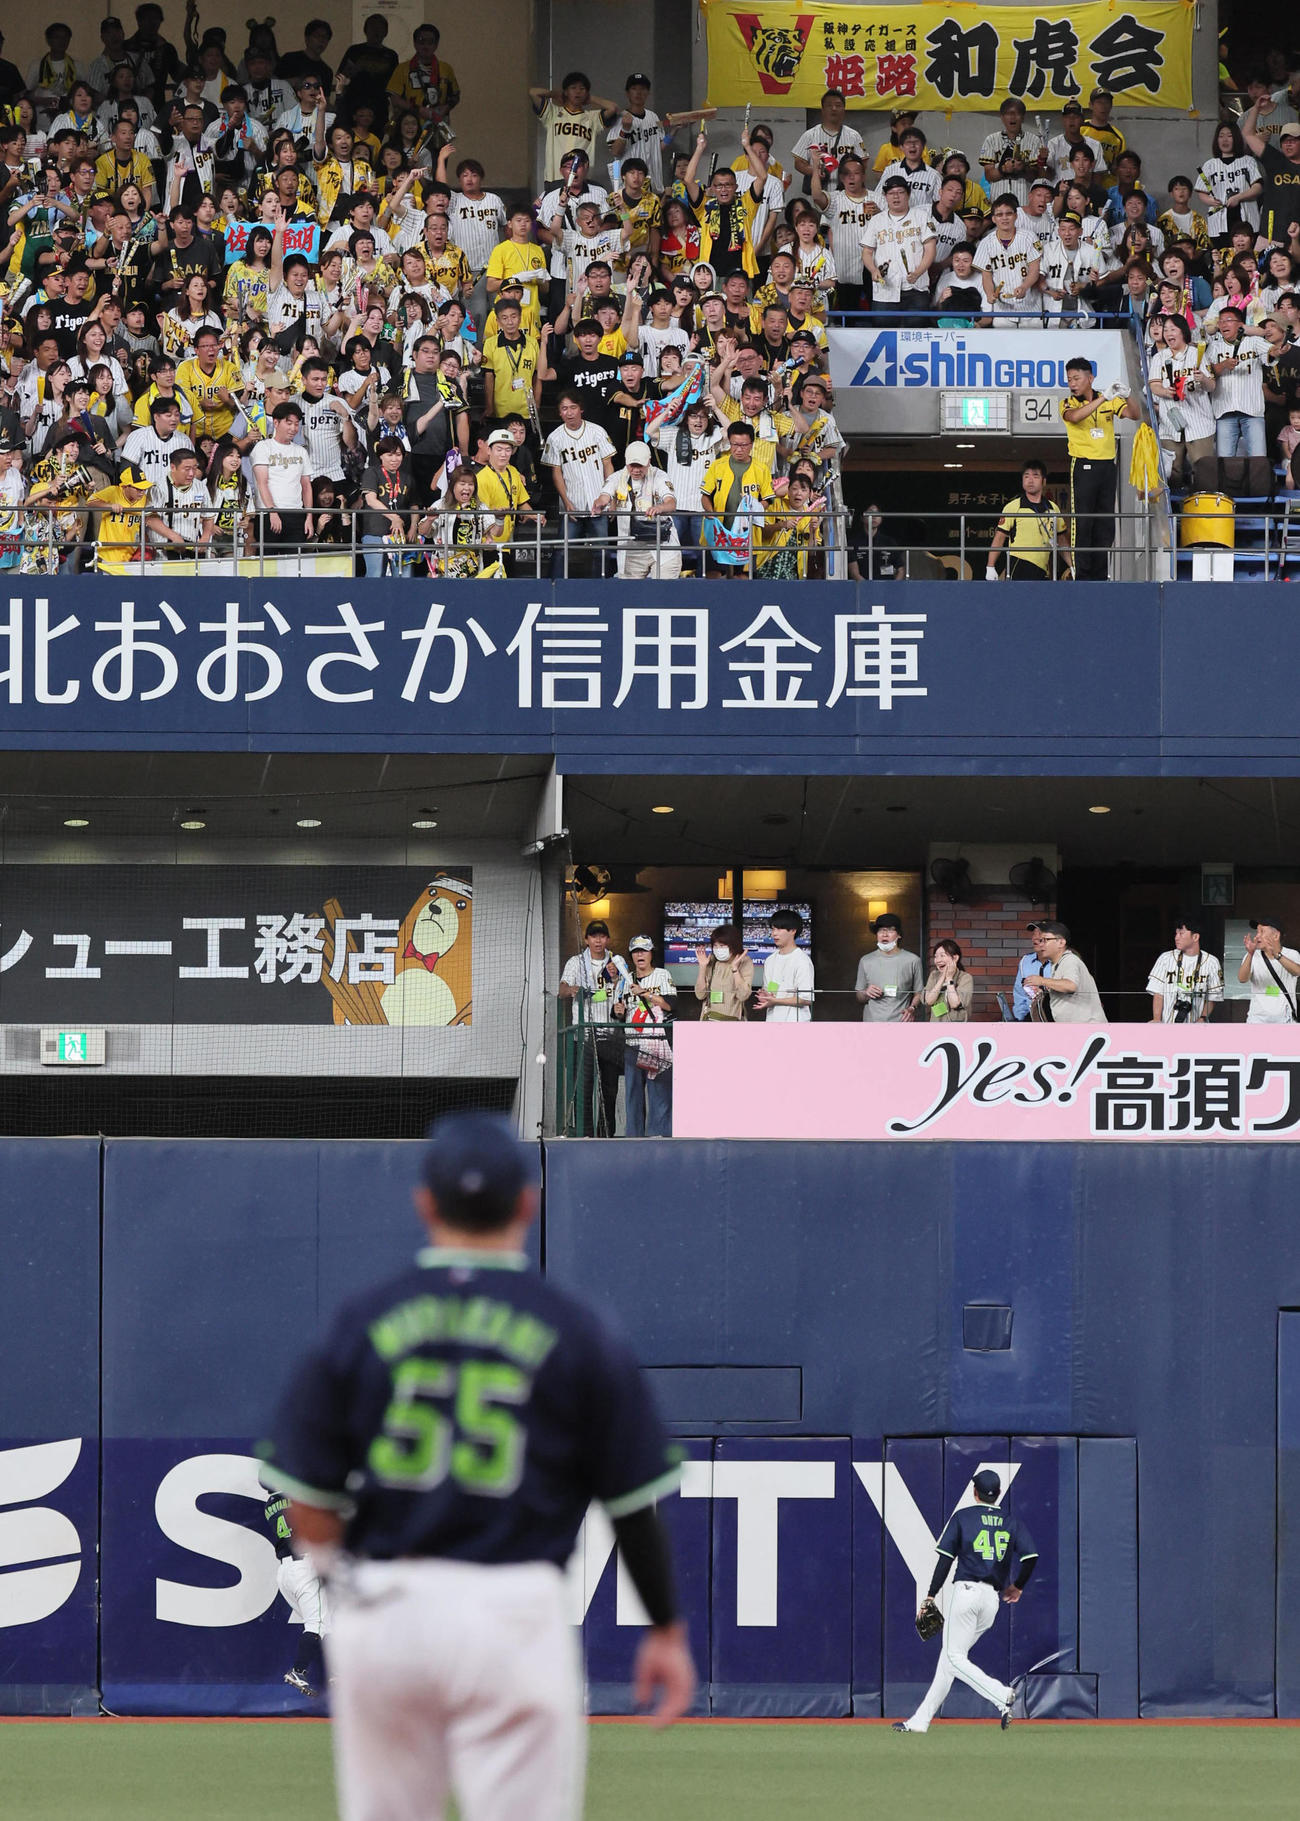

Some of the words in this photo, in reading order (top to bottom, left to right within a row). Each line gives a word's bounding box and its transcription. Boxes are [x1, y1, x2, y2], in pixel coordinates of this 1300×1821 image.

[823, 22, 917, 37] 阪神タイガース
[823, 38, 917, 52] 私設応援団
[924, 13, 1166, 98] 和虎会
[824, 54, 918, 97] 姫路
[554, 122, 593, 142] TIGERS
[877, 226, 921, 245] Tigers
[575, 242, 611, 261] Tigers
[990, 252, 1027, 270] Tigers
[1020, 266, 1028, 278] 8
[574, 370, 615, 388] Tigers
[995, 359, 1098, 388] GROU
[1025, 399, 1052, 422] 34
[301, 412, 339, 430] igers
[594, 460, 600, 471] 1
[193, 518, 198, 528] 1
[0, 598, 928, 710] 北おおさか信用金庫
[368, 1356, 532, 1498] 55
[155, 1453, 1022, 1627] STY
[972, 1529, 1011, 1562] 46
